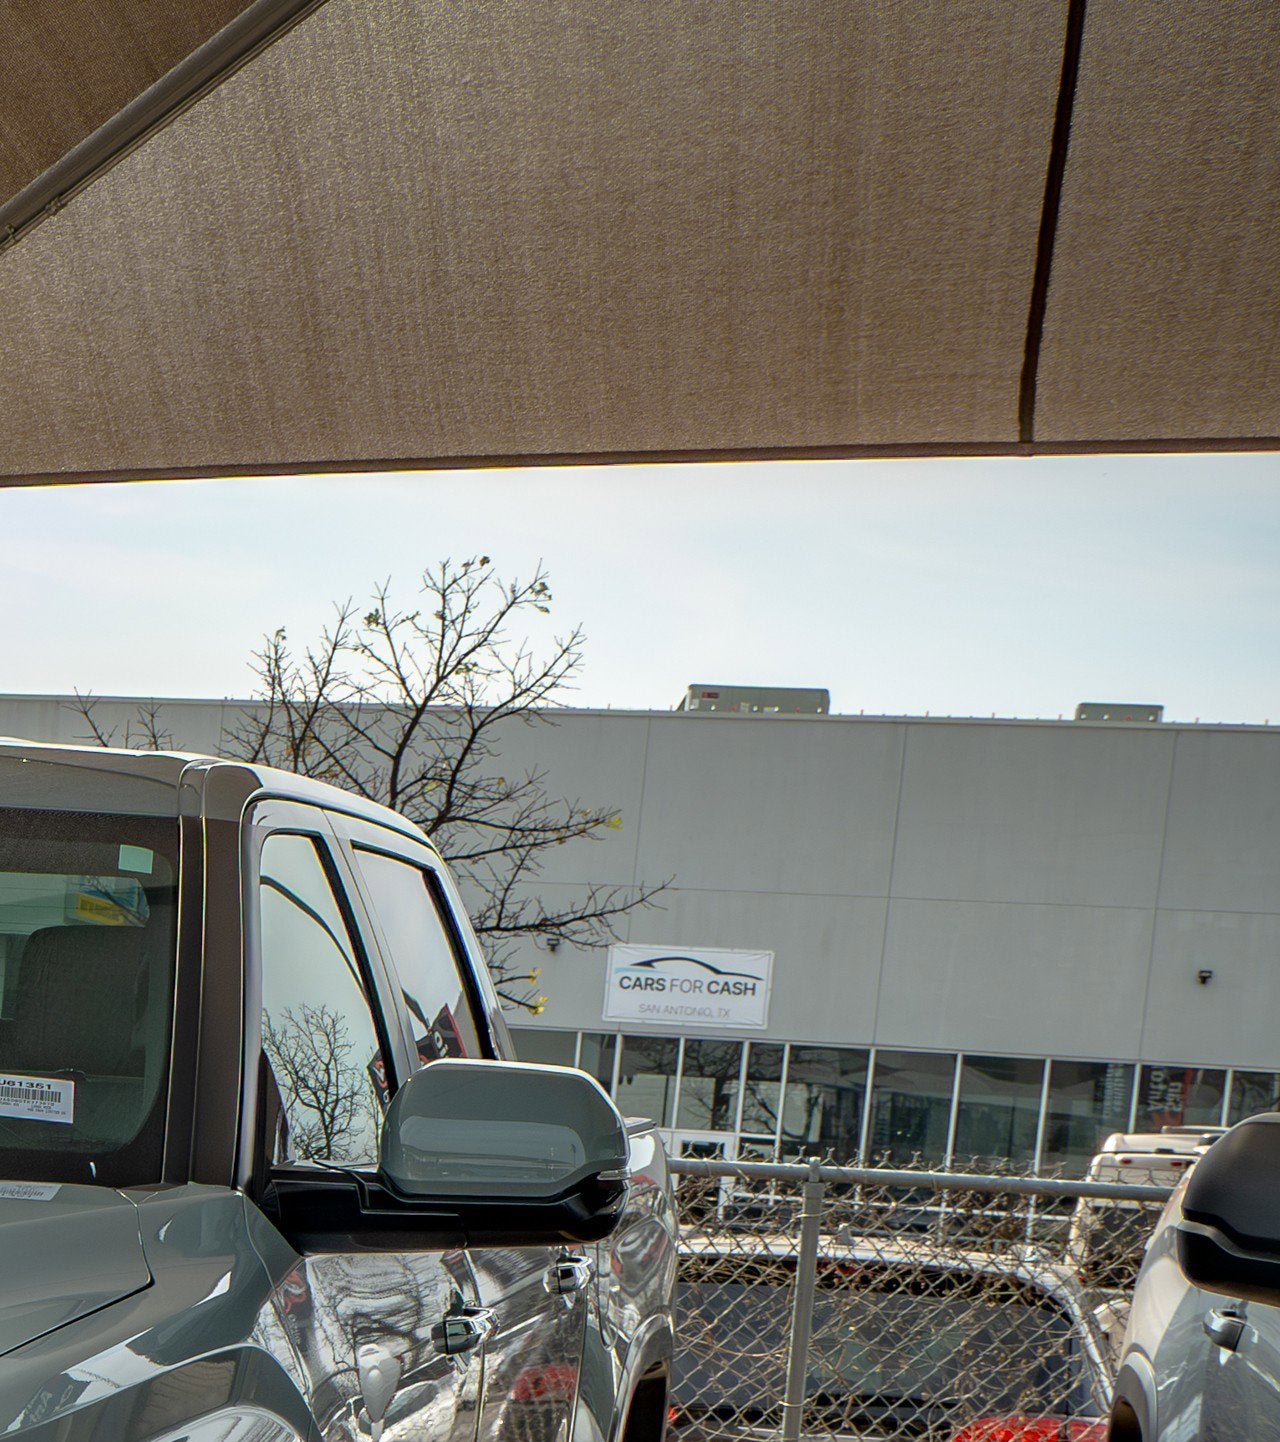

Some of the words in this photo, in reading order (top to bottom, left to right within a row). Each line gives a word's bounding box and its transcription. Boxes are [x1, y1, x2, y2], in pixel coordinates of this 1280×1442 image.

[619, 976, 666, 992] CARS
[669, 978, 703, 993] FOR
[707, 980, 756, 996] CASH
[639, 1003, 660, 1014] SAN
[717, 1007, 732, 1018] TX
